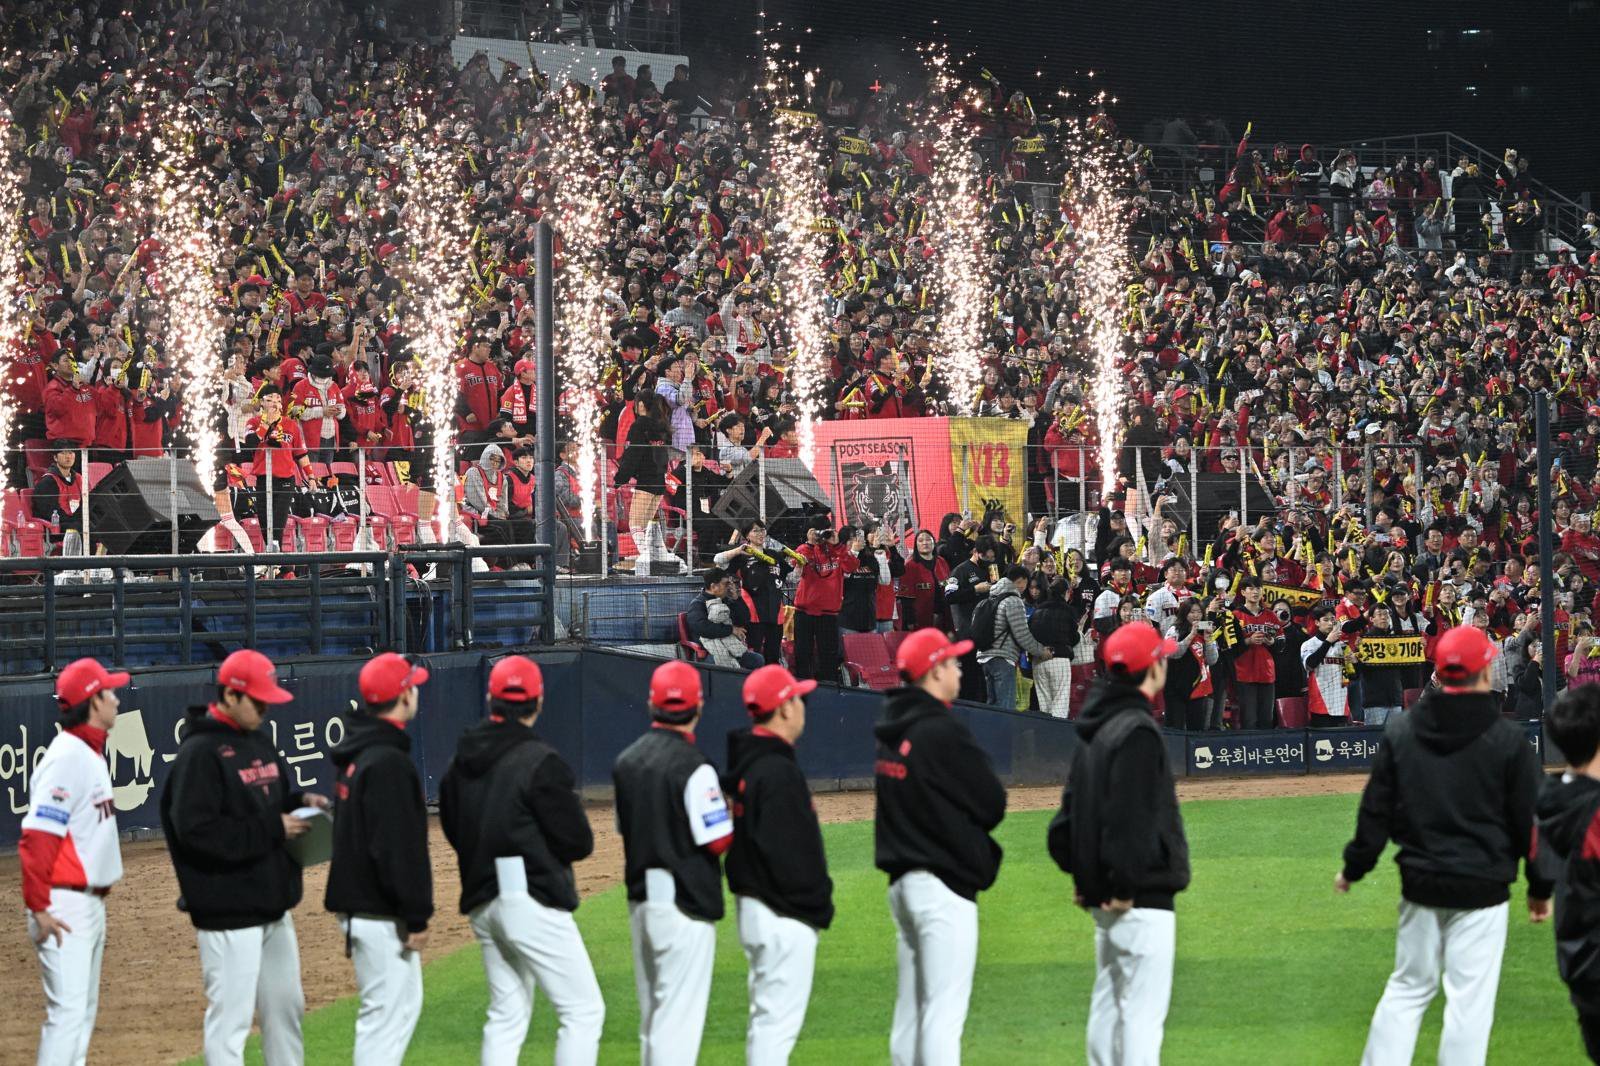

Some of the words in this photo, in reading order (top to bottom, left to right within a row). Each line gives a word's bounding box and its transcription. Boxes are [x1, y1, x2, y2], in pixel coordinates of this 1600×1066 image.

[840, 442, 909, 459] POSTSEASON
[1399, 641, 1422, 657] 기아
[1216, 743, 1304, 766] 육회바른연어
